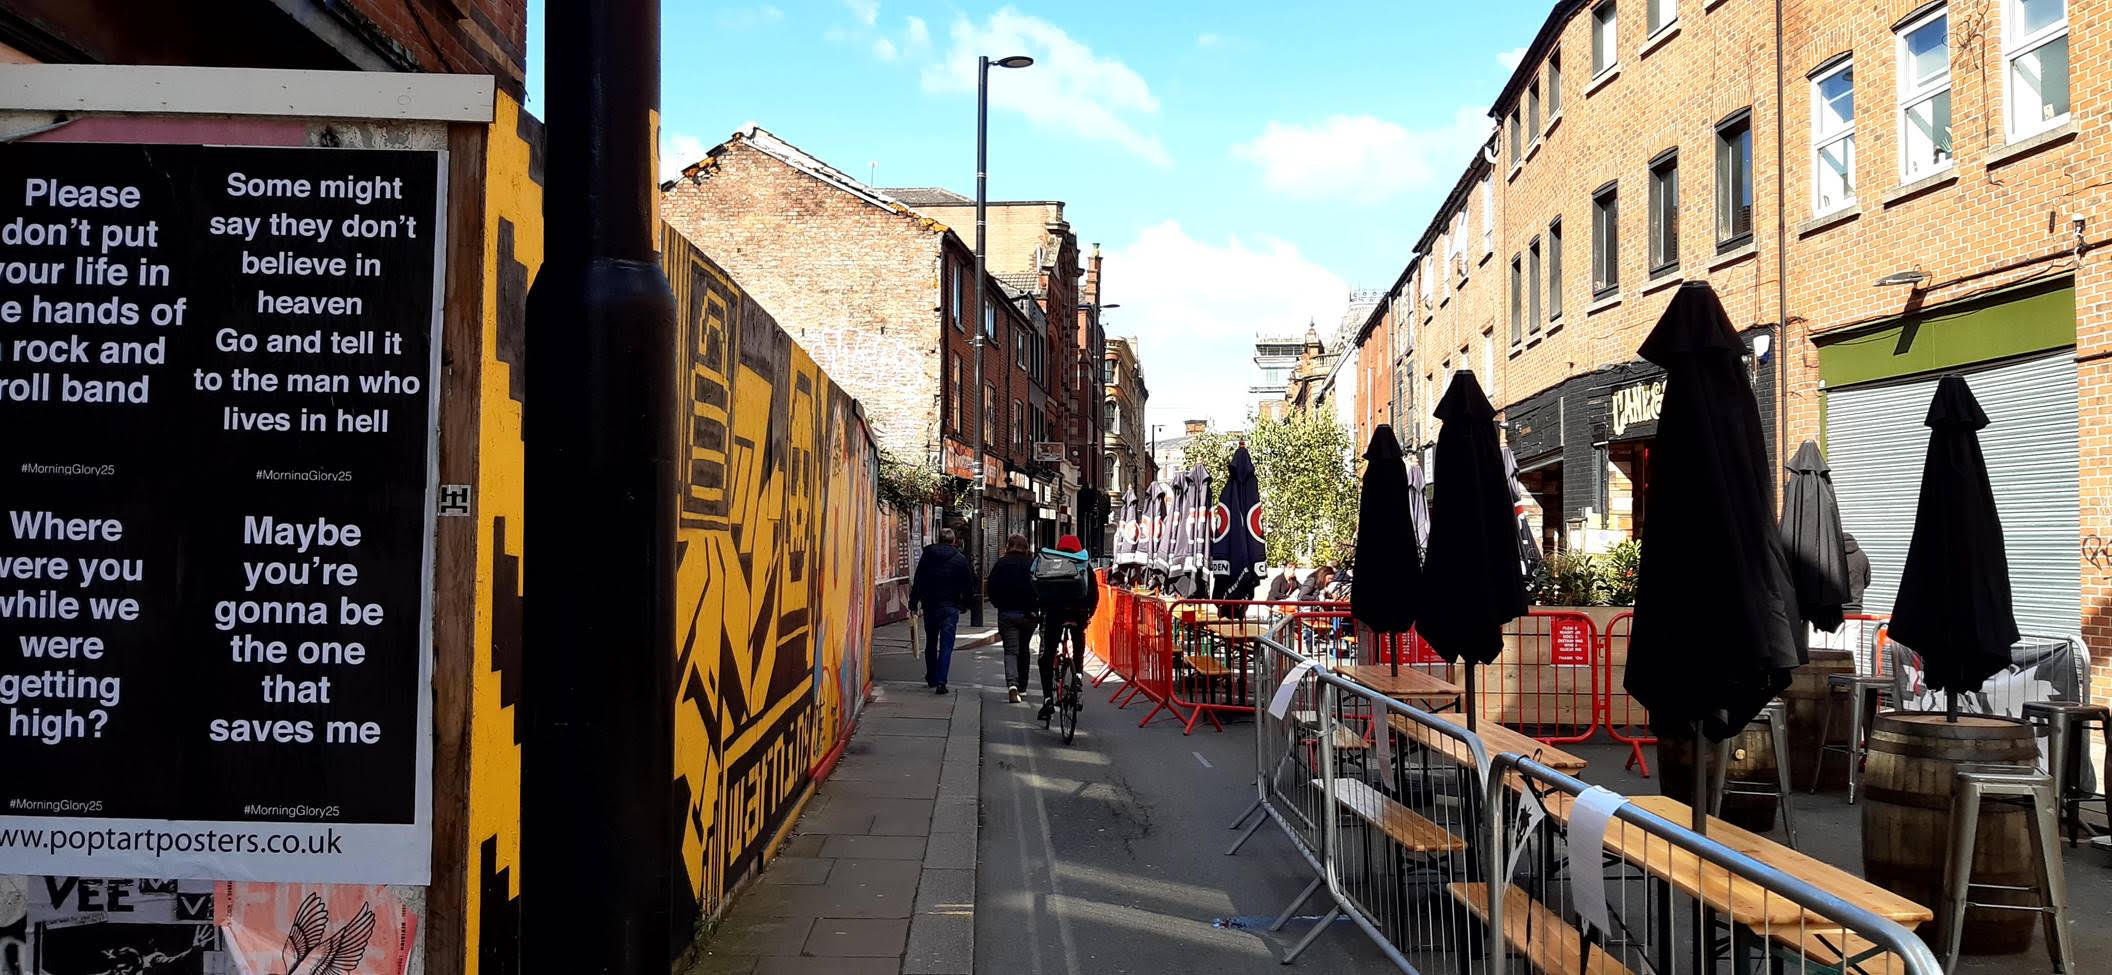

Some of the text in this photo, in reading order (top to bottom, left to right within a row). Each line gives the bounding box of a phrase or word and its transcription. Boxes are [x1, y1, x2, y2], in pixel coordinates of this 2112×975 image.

[26, 179, 140, 208] Please
[227, 173, 402, 204] Some might
[2, 217, 158, 253] don't put
[210, 213, 417, 242] say they don't
[0, 257, 169, 286] our life in
[242, 251, 381, 276] believe in
[33, 295, 139, 325] hands
[151, 298, 186, 325] of
[258, 290, 362, 315] heaven
[13, 335, 89, 362] rock
[100, 337, 165, 364] and
[216, 328, 402, 354] Go and tell it
[62, 374, 149, 403] band
[194, 368, 420, 394] to the man who
[224, 407, 388, 433] lives in hell
[21, 463, 115, 476] #MorningGlory25
[255, 469, 353, 482] #MorningGlory25
[10, 511, 122, 541] Where
[244, 515, 361, 553] Maybe
[78, 558, 143, 587] you
[244, 557, 357, 591] you're
[90, 598, 140, 621] we
[215, 597, 383, 631] gonna be
[19, 636, 104, 660] were
[231, 634, 365, 665] the one
[0, 669, 120, 707] getting
[262, 674, 330, 703] that
[9, 707, 108, 745] high?
[209, 718, 381, 744] saves me
[9, 798, 103, 813] #MorningGlory25
[243, 804, 340, 818] #MorningGlory25
